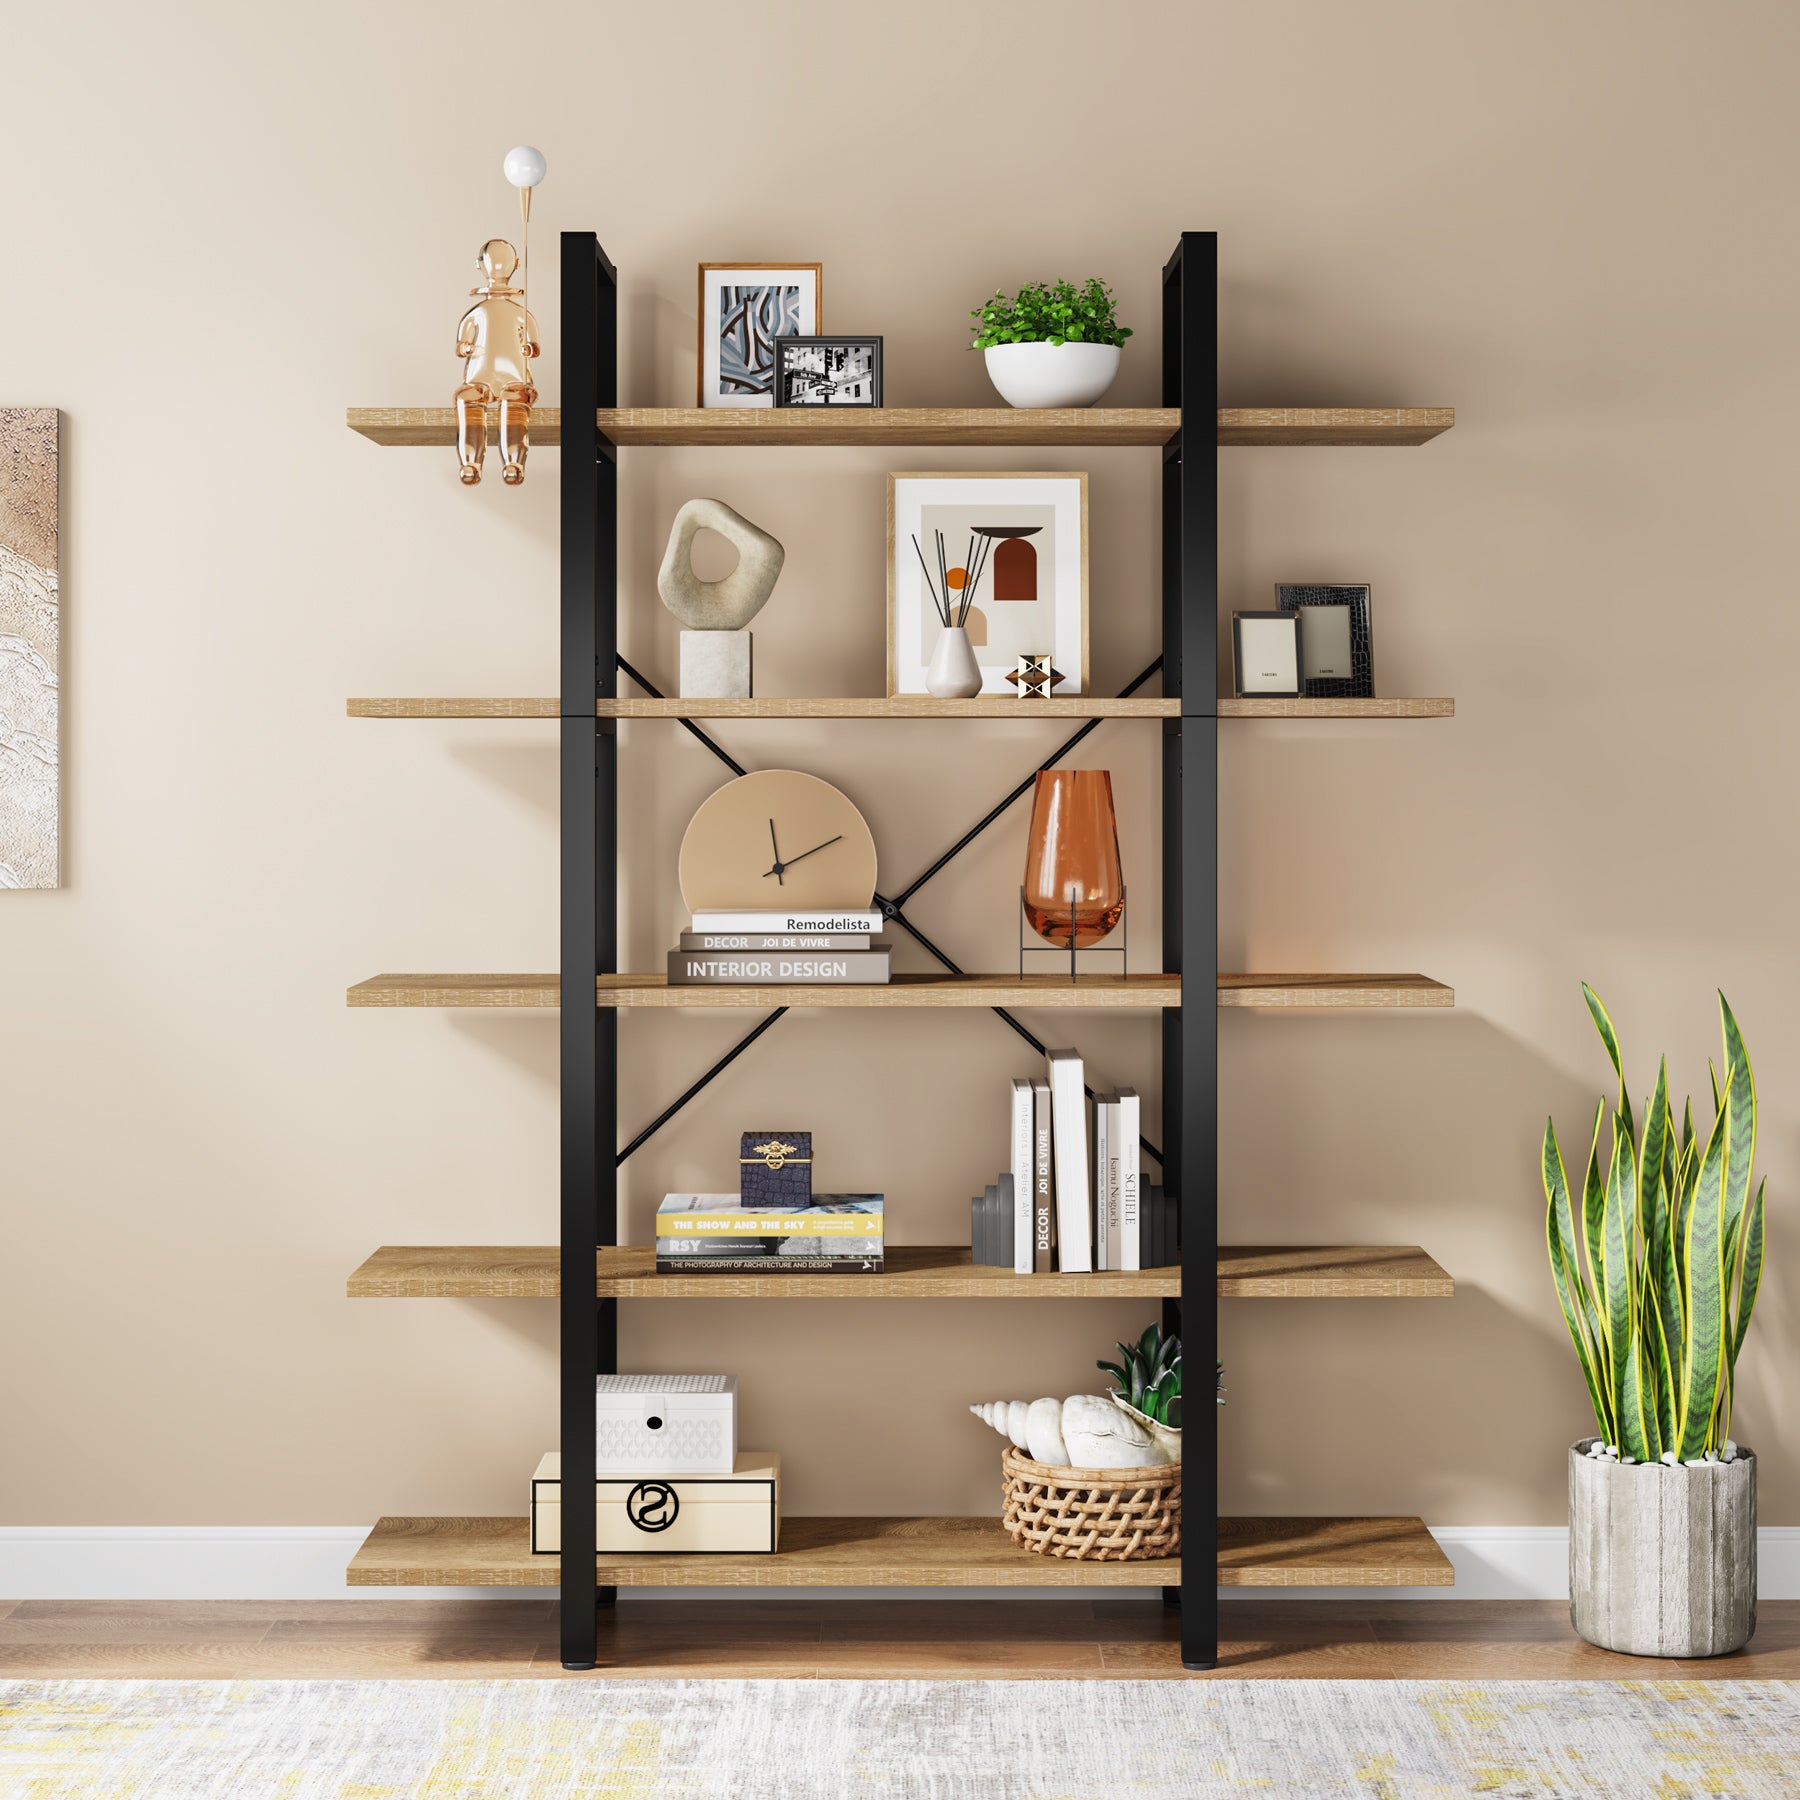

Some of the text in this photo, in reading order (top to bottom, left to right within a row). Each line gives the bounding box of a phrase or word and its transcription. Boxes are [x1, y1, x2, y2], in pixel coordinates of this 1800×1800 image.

[787, 918, 870, 930] Remodelista
[704, 937, 831, 948] DECOR JOI DE VIVRE
[687, 962, 847, 977] INTERIOR DESIGN
[1021, 1103, 1030, 1149] Interiors
[1021, 1162, 1030, 1197] Atelier
[1038, 1129, 1049, 1250] DECOR JOI DE VIVRE
[1109, 1157, 1119, 1227] Isamu Noguchi
[1125, 1173, 1136, 1225] SCHIELE
[1021, 1201, 1030, 1218] AM
[673, 1221, 693, 1230] THE
[734, 1221, 758, 1230] AND
[761, 1221, 781, 1230] THE
[783, 1221, 805, 1230] SKY
[669, 1240, 701, 1252] RSY
